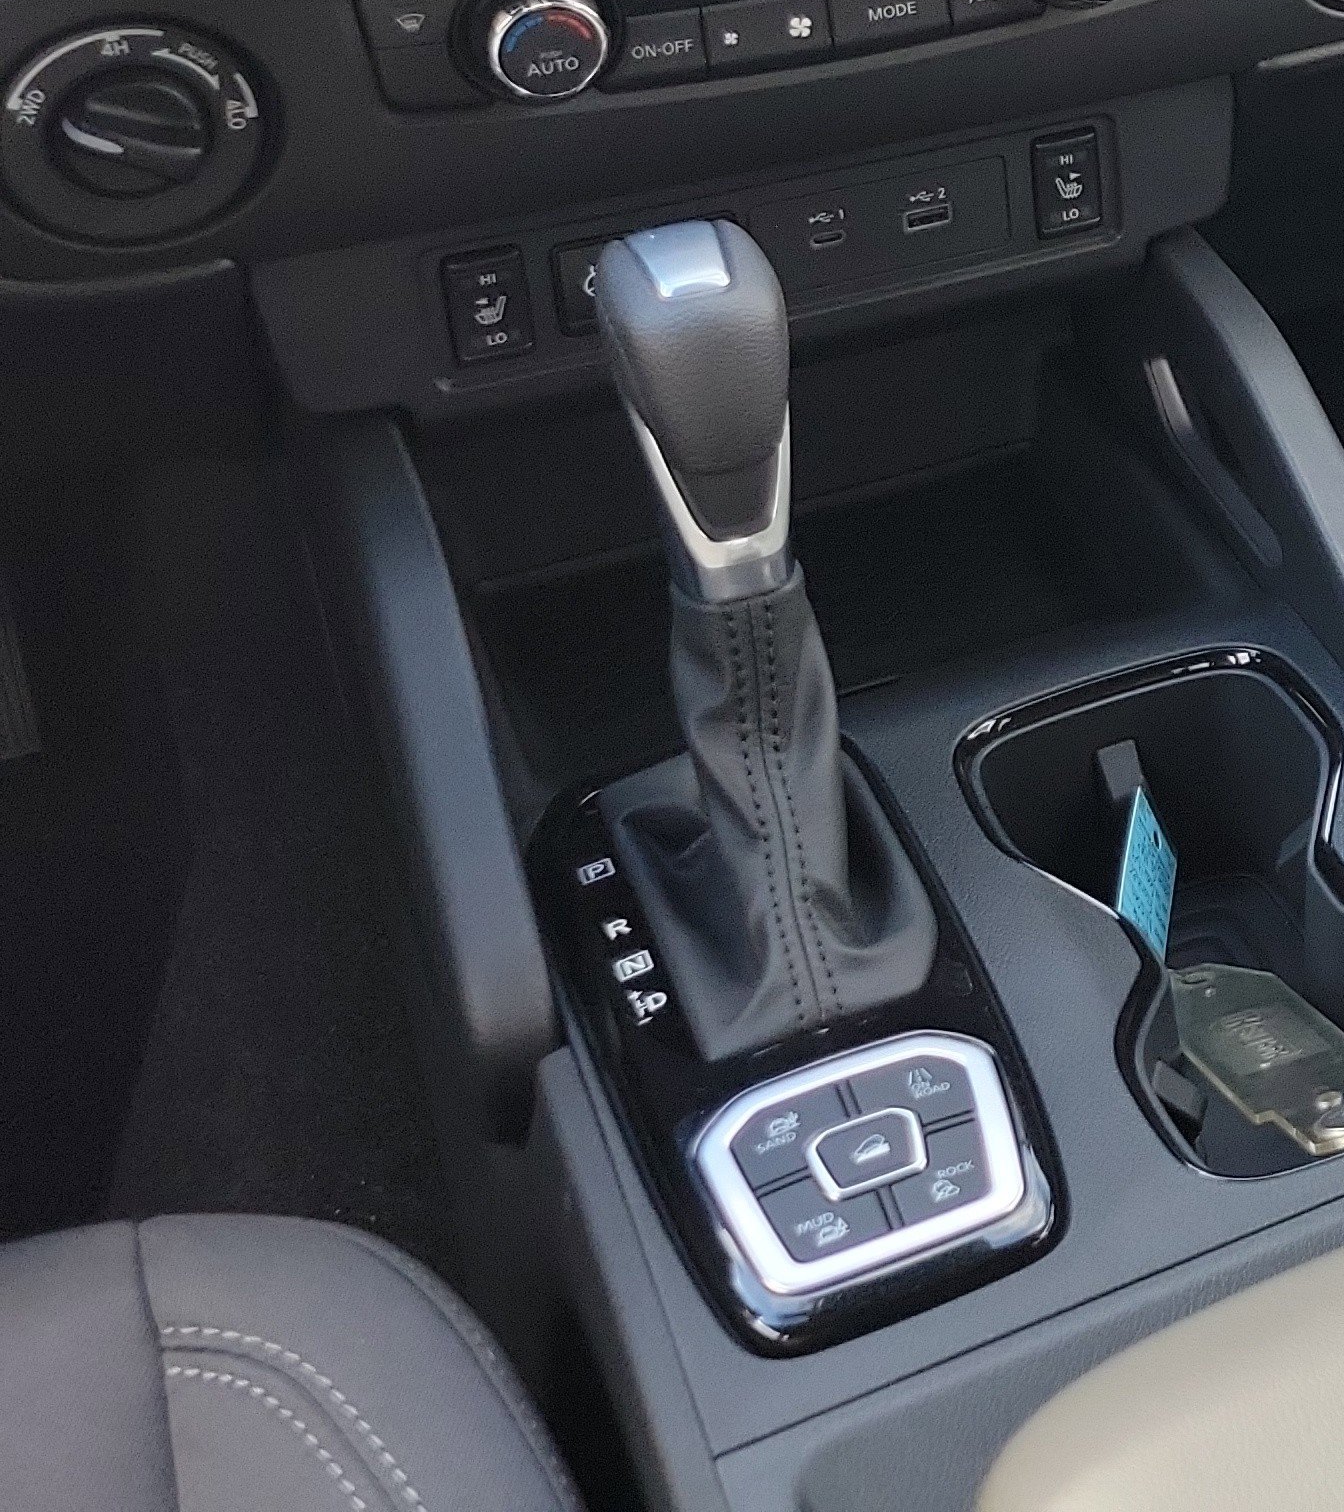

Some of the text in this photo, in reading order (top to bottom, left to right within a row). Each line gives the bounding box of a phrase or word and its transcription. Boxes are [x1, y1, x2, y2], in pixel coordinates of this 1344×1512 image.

[868, 1, 917, 21] MODE
[100, 39, 129, 56] 4H
[178, 42, 218, 70] PUSH
[527, 57, 579, 77] AUTO
[16, 89, 46, 126] 2WD
[1059, 154, 1073, 165] HI
[937, 188, 947, 199] 2
[1062, 209, 1079, 221] LO
[478, 273, 497, 286] HI
[486, 332, 508, 346] LO
[602, 919, 632, 940] R
[914, 1082, 950, 1100] ROAD
[755, 1132, 797, 1155] SAND
[937, 1160, 975, 1178] ROCK
[797, 1212, 835, 1234] MUD
